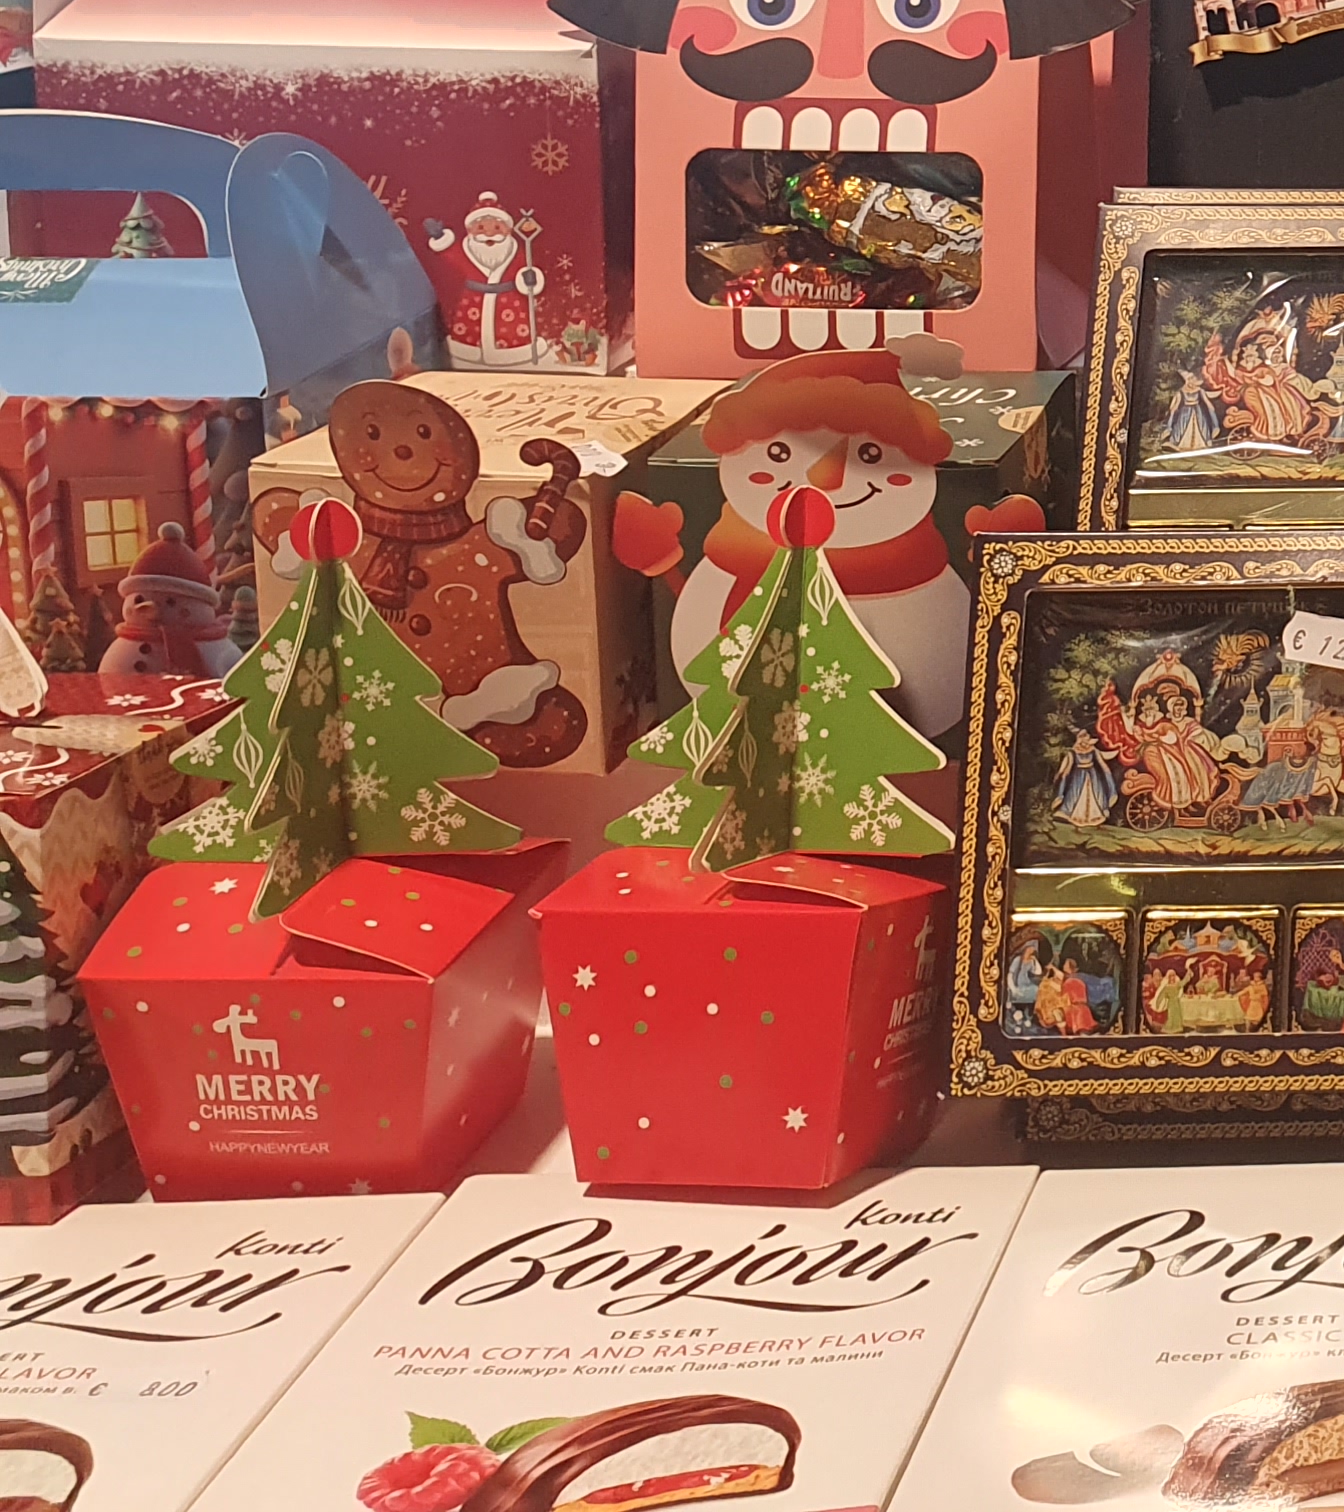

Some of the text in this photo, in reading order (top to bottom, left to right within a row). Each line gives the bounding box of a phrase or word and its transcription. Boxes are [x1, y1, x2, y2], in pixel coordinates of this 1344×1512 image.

[1293, 630, 1306, 650] €
[195, 1074, 320, 1101] MERRY
[200, 1104, 318, 1121] CHRISTMAS
[209, 1141, 330, 1154] HAPPYNEWYEAR
[846, 1199, 961, 1232] Konti
[227, 1229, 344, 1261] Konti
[416, 1217, 979, 1315] Bonjour
[0, 1253, 351, 1342] njour
[1235, 1314, 1340, 1328] DESSERT
[373, 1327, 927, 1361] PANNA COTTA AND RASPBERRY FLAVOR
[610, 1327, 720, 1341] DESSERT
[1225, 1329, 1344, 1346] CLASSIC
[395, 1363, 468, 1378] Десерт
[573, 1362, 625, 1376] Konti
[628, 1363, 677, 1375] смак
[679, 1356, 782, 1373] Пана-коти
[787, 1354, 807, 1366] та
[811, 1349, 885, 1364] малини
[1155, 1350, 1224, 1364] Десерт
